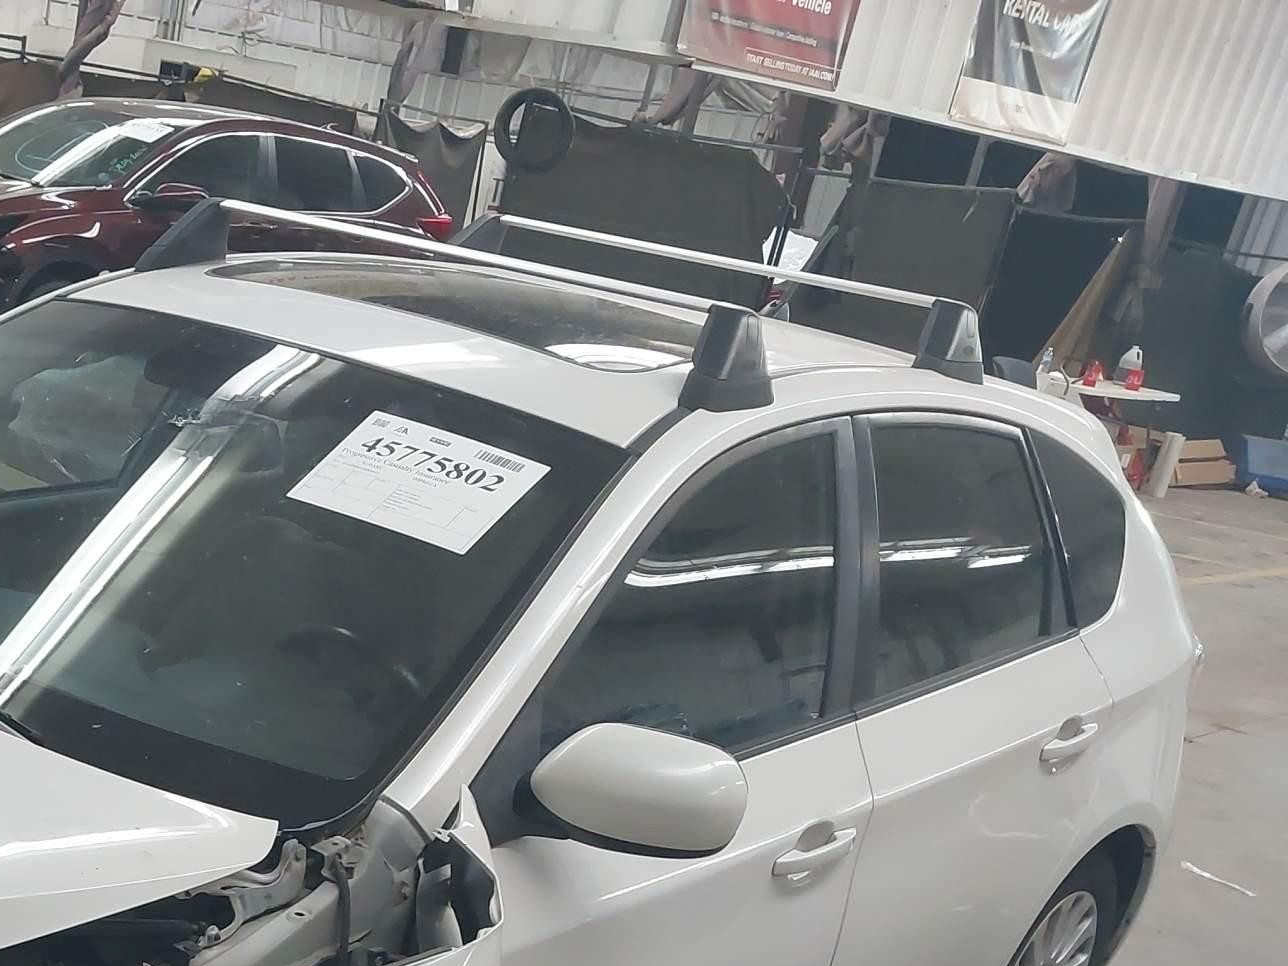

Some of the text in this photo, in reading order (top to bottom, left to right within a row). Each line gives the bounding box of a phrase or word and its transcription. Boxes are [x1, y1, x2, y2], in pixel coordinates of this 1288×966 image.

[1003, 0, 1050, 28] RENTAL
[763, 56, 785, 70] SELLING
[361, 437, 505, 492] 45775802
